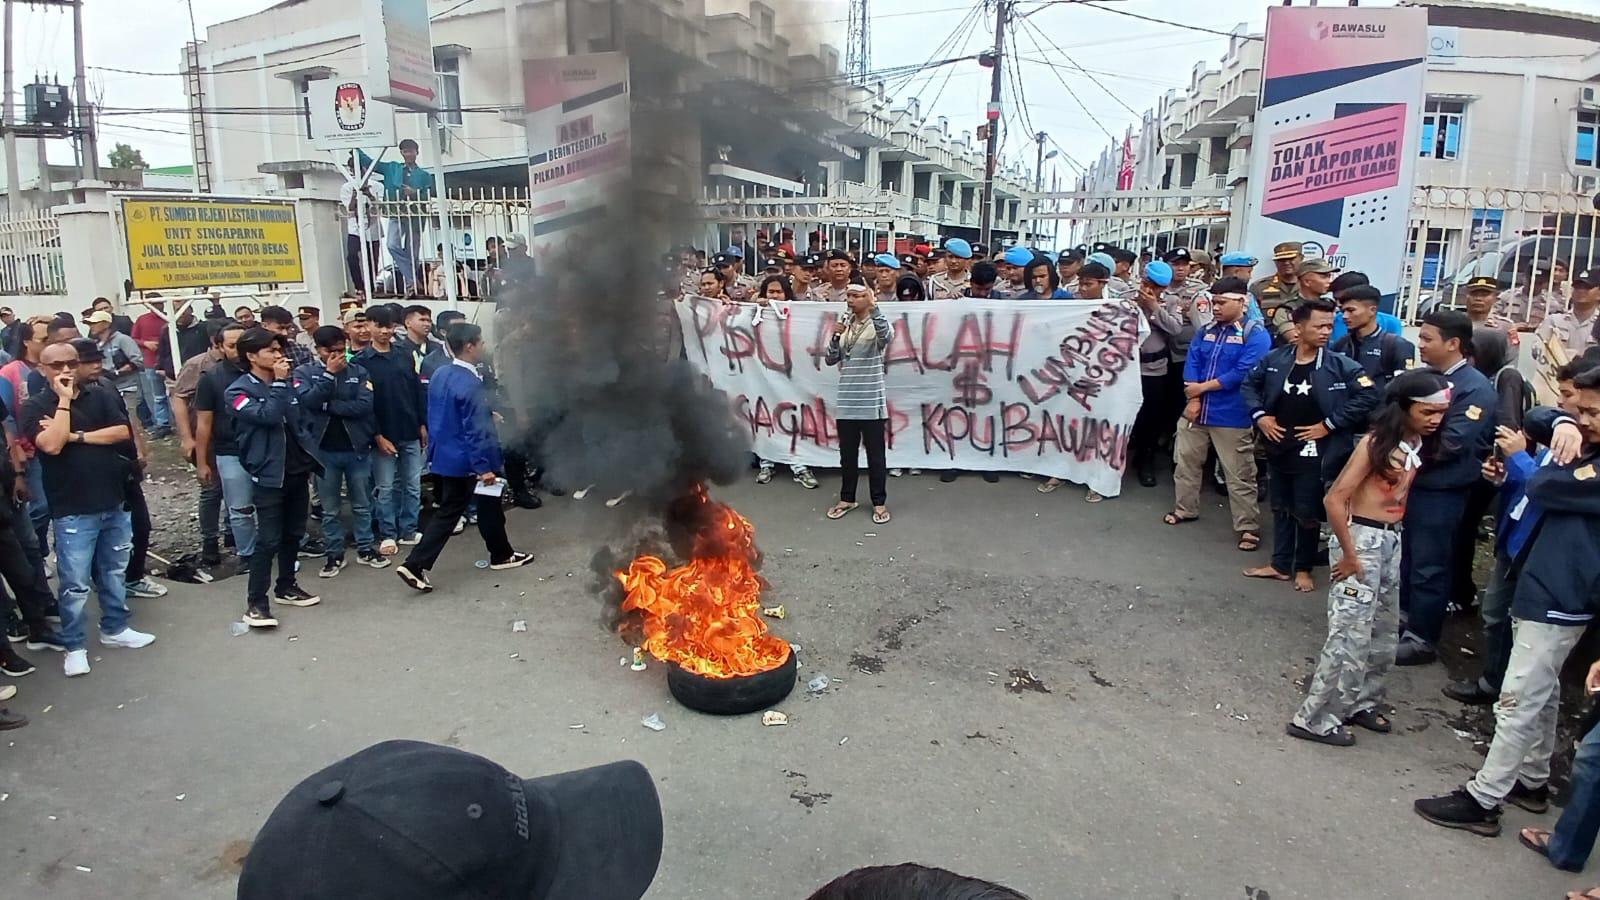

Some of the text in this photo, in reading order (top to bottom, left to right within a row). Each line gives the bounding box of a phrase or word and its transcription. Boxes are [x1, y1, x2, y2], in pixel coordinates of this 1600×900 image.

[1332, 23, 1386, 33] BAWASLU
[560, 119, 592, 143] ASN
[548, 133, 607, 161] BERINTEGRITAS
[1274, 140, 1325, 166] TOLAK
[1271, 140, 1397, 182] DAN LAPORKAN
[534, 164, 565, 185] PILKADA
[1305, 158, 1396, 189] POLITIK UANG
[164, 207, 197, 222] SUMBER
[198, 208, 226, 222] REJEKI
[227, 208, 258, 222] LESTARI
[164, 228, 265, 239] UNIT SINGAPARNA
[141, 243, 289, 257] JUAL BELI SEPEDA MOTOR BEKAS
[921, 402, 995, 460] KPU
